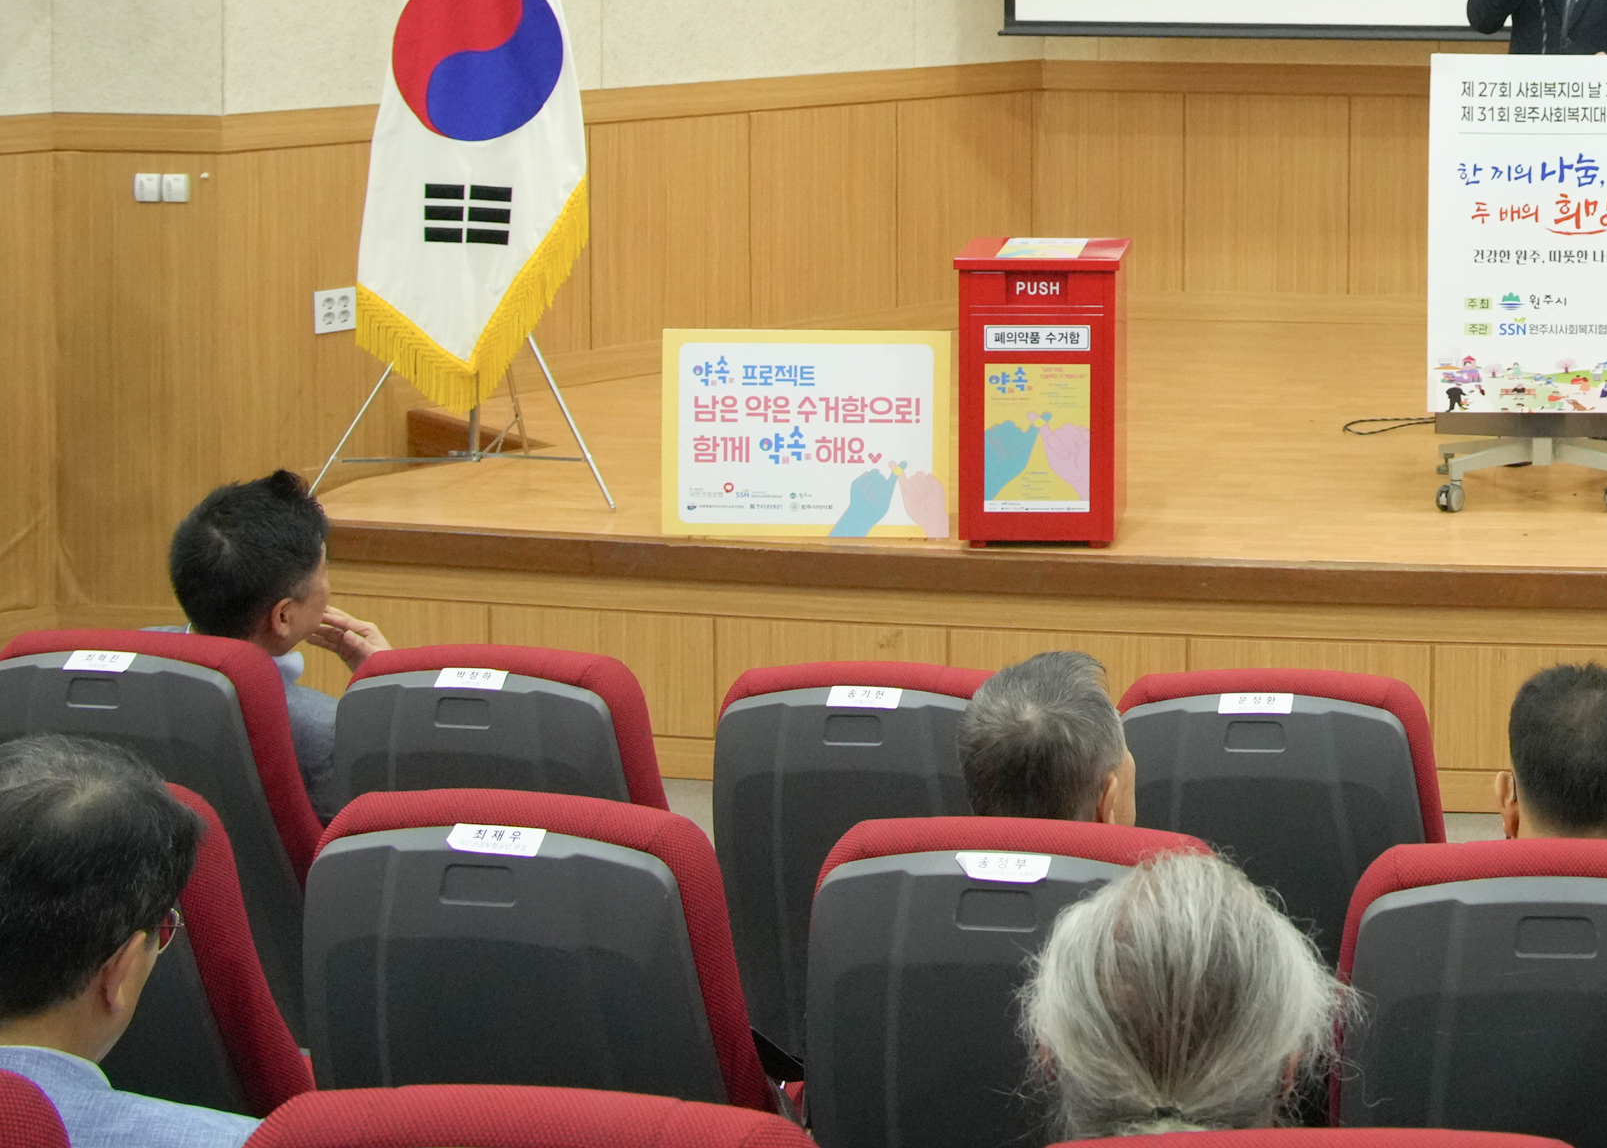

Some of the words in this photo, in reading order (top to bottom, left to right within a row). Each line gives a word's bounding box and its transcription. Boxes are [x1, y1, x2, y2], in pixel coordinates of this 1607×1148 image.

[1461, 80, 1474, 99] 제
[1478, 80, 1511, 99] 27회
[1516, 80, 1583, 99] 사회복지의
[1588, 80, 1601, 99] 날
[1461, 106, 1474, 123] 제
[1477, 106, 1510, 123] 31회
[1457, 163, 1483, 186] 한
[1491, 164, 1532, 184] 끼의
[1540, 152, 1605, 188] 나눔,
[1471, 202, 1490, 224] 두
[1499, 203, 1539, 223] 배의
[1473, 249, 1510, 264] 건강한
[1516, 249, 1545, 265] 원주,
[1549, 249, 1588, 264] 따뜻한
[1016, 281, 1060, 295] PUSH
[1468, 298, 1490, 309] 주최
[1529, 294, 1567, 309] 원주시
[1468, 324, 1488, 335] 주관
[1499, 323, 1527, 336] SSN
[994, 331, 1040, 345] 폐의약품
[1045, 331, 1080, 345] 수거함
[742, 365, 815, 386] 프로젝트
[693, 395, 738, 423] 남은
[745, 395, 790, 423] 약은
[797, 395, 921, 424] 수거함으로!
[693, 435, 750, 464] 함께
[816, 435, 865, 464] 해요
